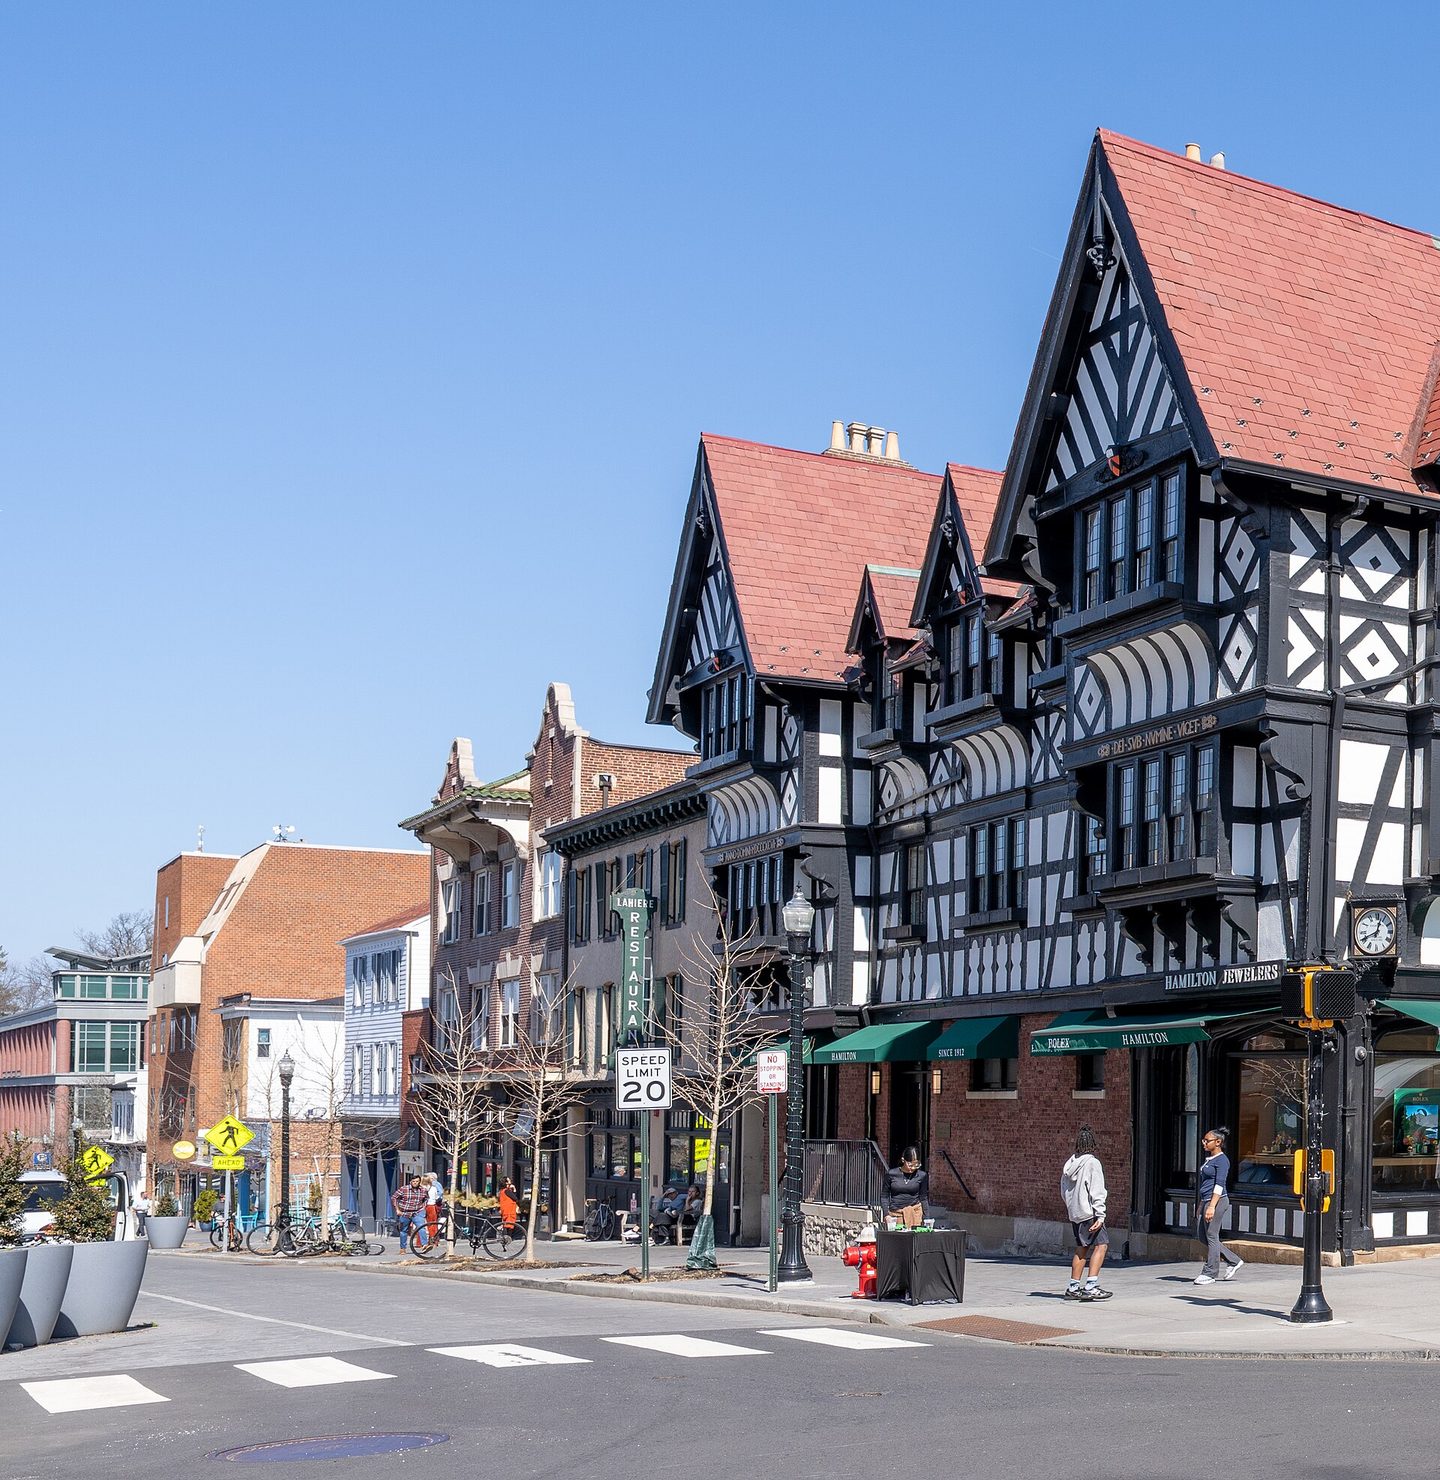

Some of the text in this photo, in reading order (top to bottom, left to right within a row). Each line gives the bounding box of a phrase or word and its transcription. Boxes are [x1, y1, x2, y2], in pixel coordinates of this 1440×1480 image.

[617, 897, 654, 908] LAHIERE
[1165, 964, 1279, 990] HAMILTON JEWELERS
[1048, 1038, 1070, 1048] ROLEX
[1122, 1032, 1168, 1046] HAMILTON
[831, 1052, 857, 1060] HAMILTON
[938, 1048, 964, 1058] SINCE 1912
[622, 1056, 666, 1066] SPEED
[767, 1056, 778, 1064] NO
[626, 1068, 661, 1078] LIMIT
[622, 1080, 666, 1102] 20
